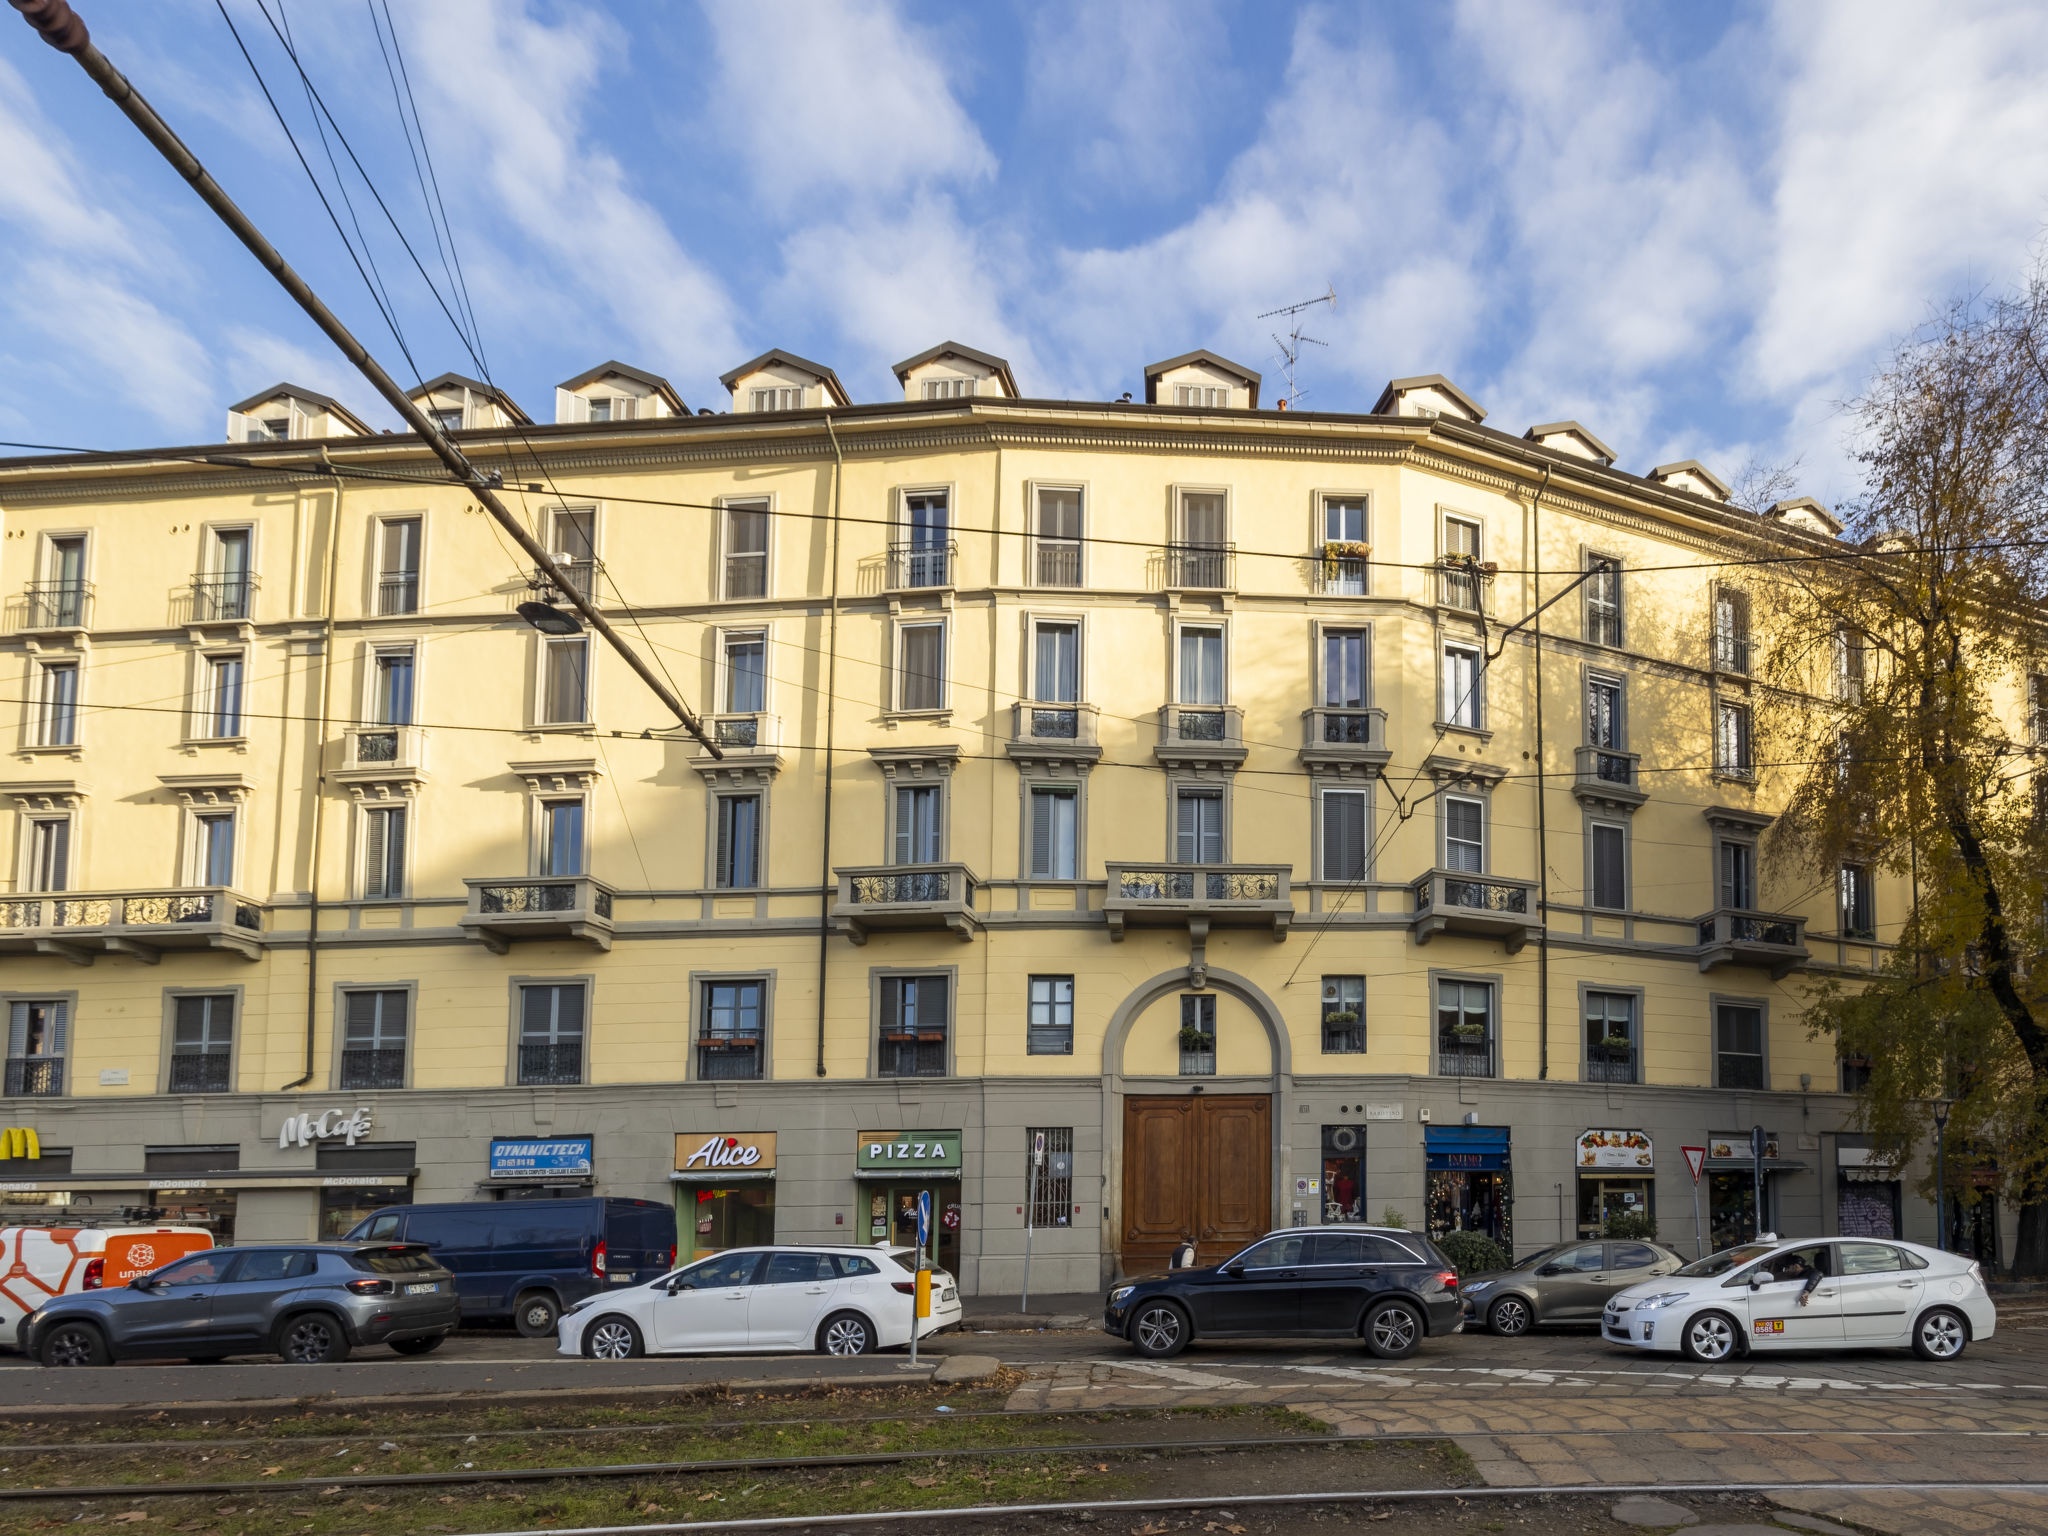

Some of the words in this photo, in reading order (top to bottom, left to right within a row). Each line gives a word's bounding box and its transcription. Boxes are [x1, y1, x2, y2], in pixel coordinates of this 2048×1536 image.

[686, 1136, 761, 1168] Alice
[870, 1143, 946, 1159] PIZZA
[149, 1179, 207, 1188] McDonald's
[323, 1177, 383, 1185] McDonald's
